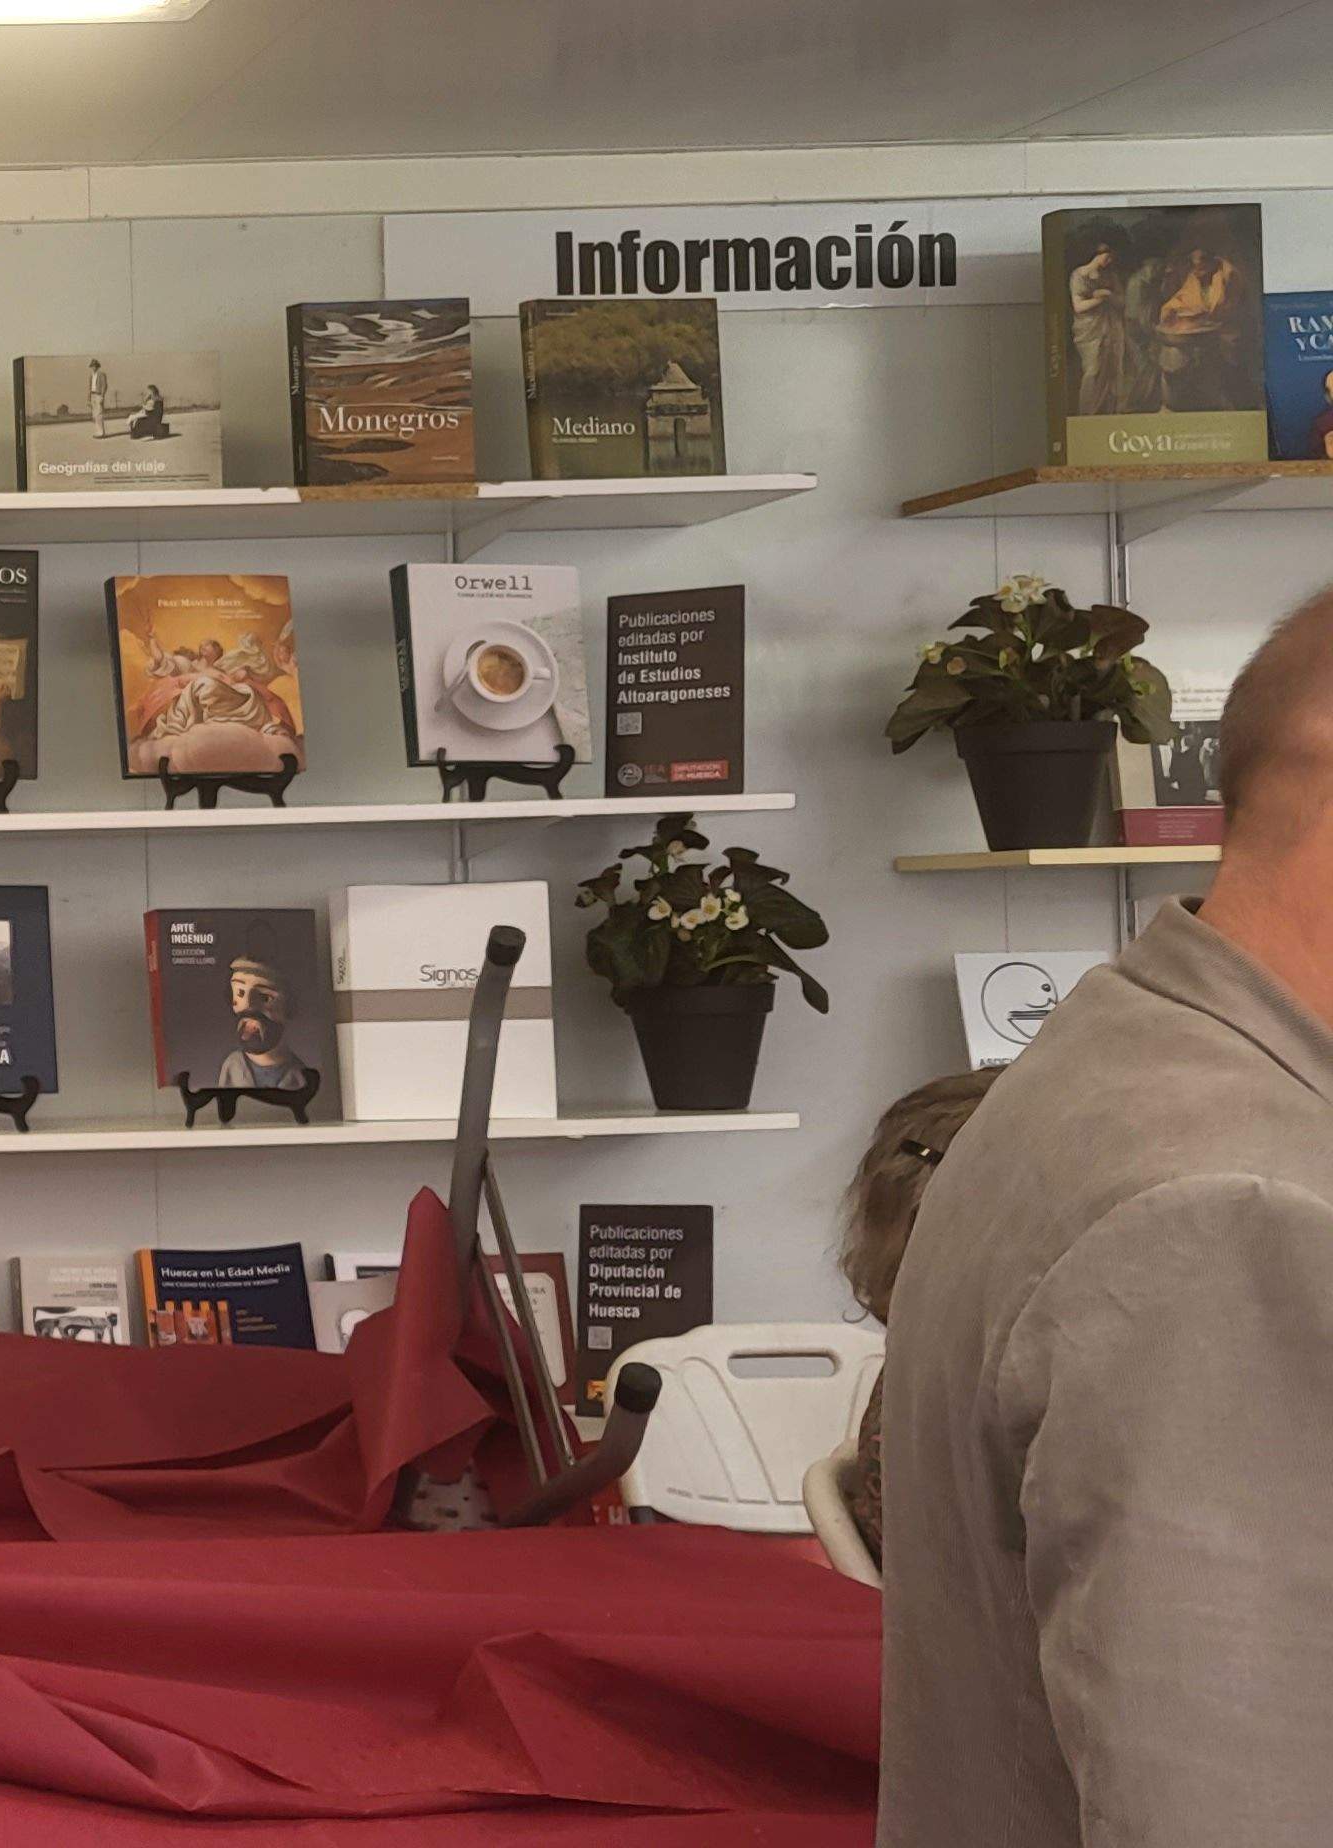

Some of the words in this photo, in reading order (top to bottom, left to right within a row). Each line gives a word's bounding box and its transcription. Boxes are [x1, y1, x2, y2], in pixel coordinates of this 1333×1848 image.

[555, 221, 957, 296] Información
[319, 406, 459, 438] Monegros
[552, 416, 635, 436] Mediano
[1108, 430, 1172, 458] Goya
[112, 461, 131, 473] del
[135, 460, 166, 474] viaje
[455, 575, 533, 590] Orwell
[619, 609, 715, 628] Publicaciones
[618, 630, 676, 647] editadas
[680, 629, 704, 645] por
[618, 650, 677, 666] Instituto
[618, 670, 635, 684] de
[640, 667, 701, 684] Estudios
[616, 685, 730, 705] Altoaragoneses
[170, 923, 194, 933] ARTE
[171, 934, 214, 944] INGENUO
[420, 964, 479, 987] Signos
[590, 1224, 683, 1241] Publicaciones
[589, 1247, 645, 1260] editadas
[650, 1247, 673, 1261] por
[161, 1266, 198, 1278] Huesca
[215, 1268, 225, 1277] la
[227, 1266, 254, 1277] Edad
[256, 1263, 290, 1275] Media
[589, 1263, 665, 1280] Diputación
[589, 1282, 659, 1298] Provincial
[665, 1283, 682, 1298] de
[589, 1303, 640, 1318] Huesca
